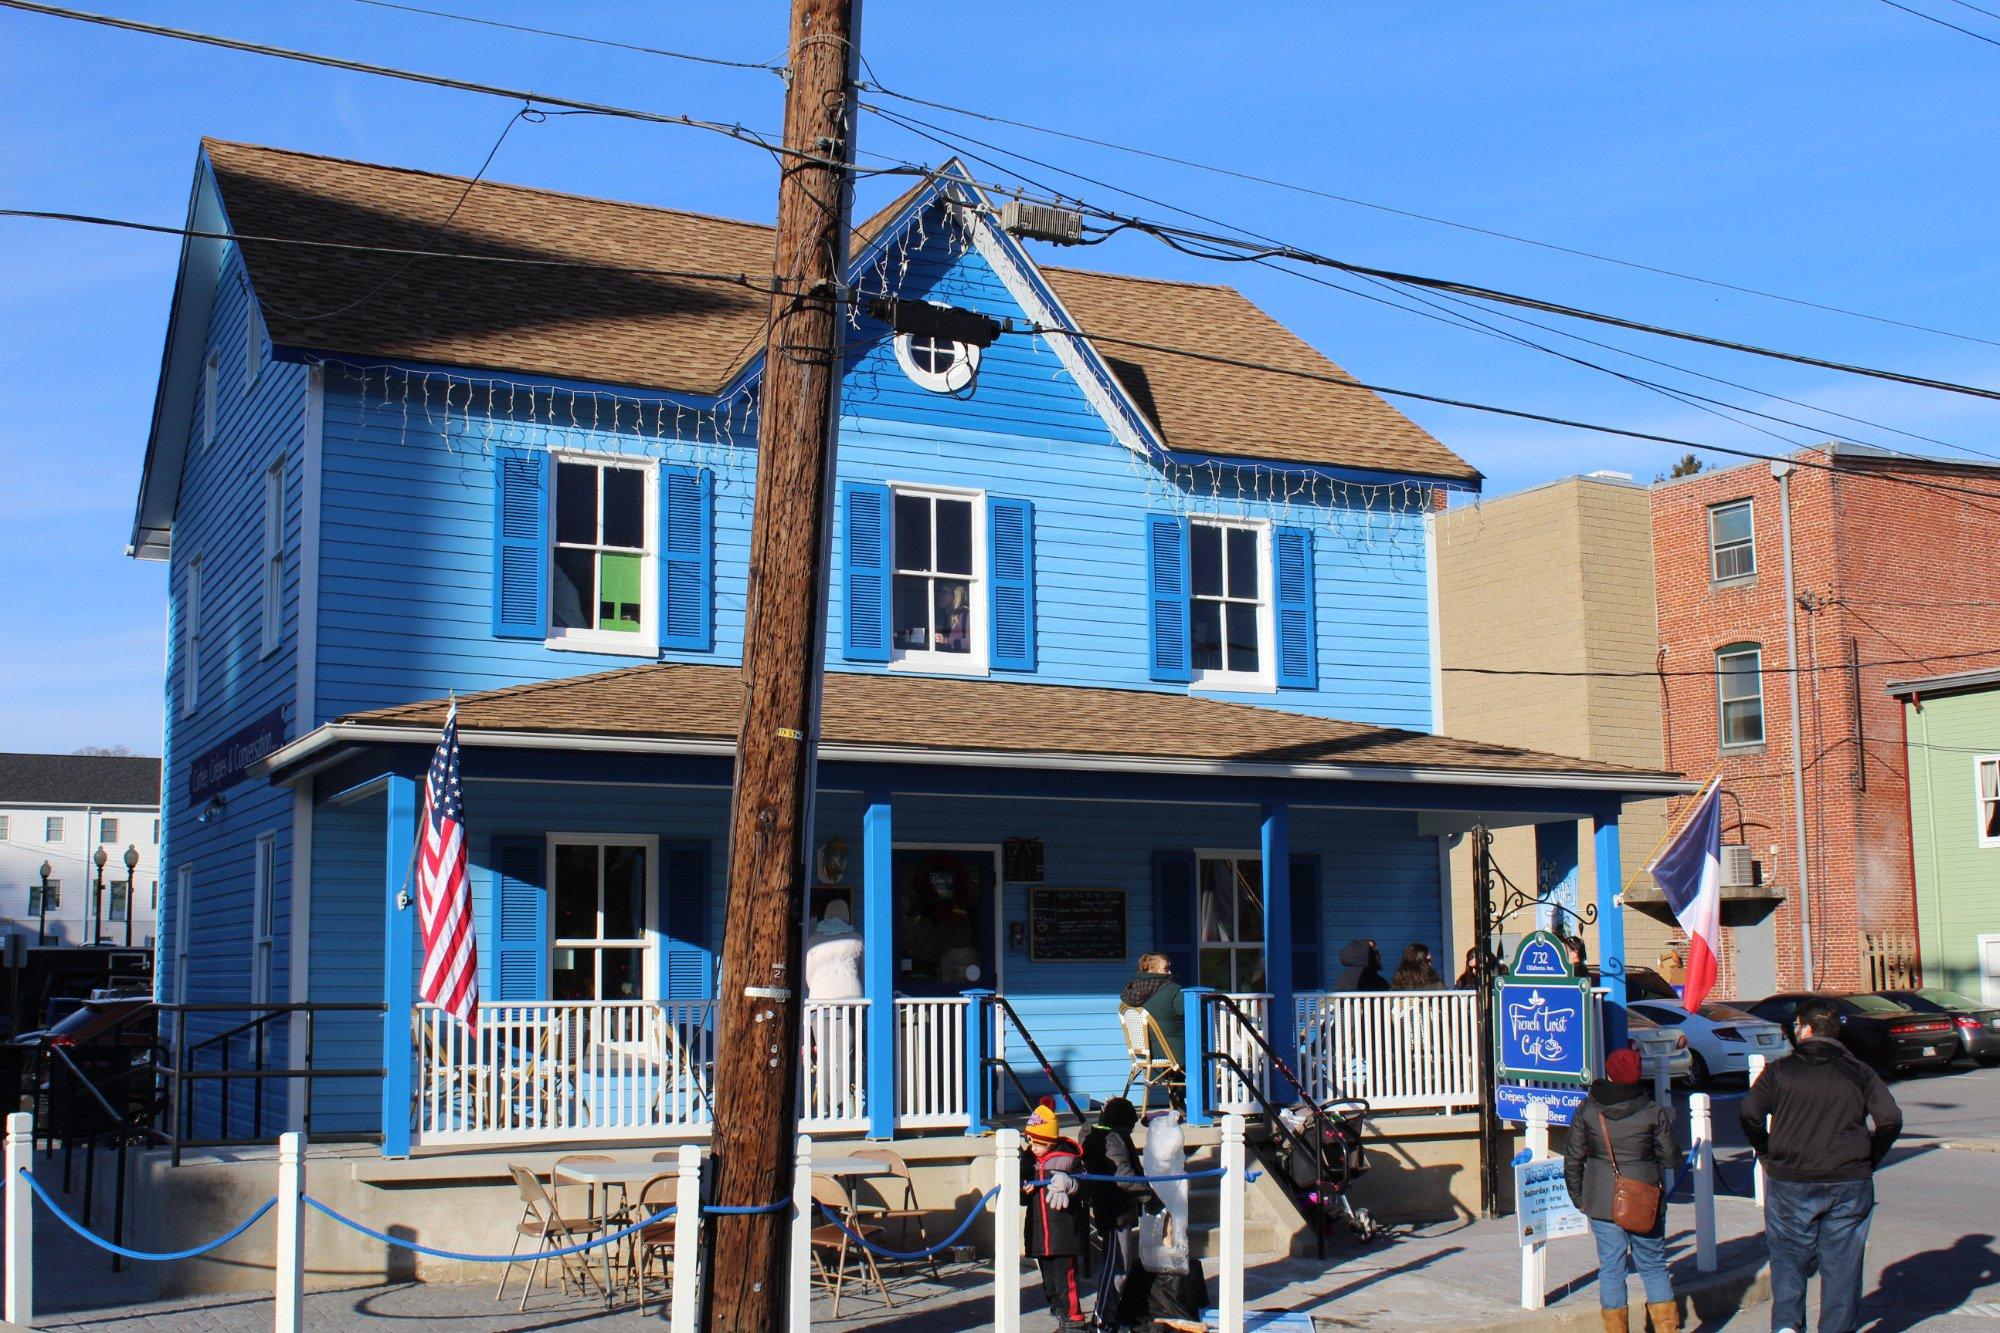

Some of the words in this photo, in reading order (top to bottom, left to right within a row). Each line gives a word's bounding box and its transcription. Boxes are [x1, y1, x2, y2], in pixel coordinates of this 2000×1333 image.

[1532, 951, 1548, 964] 732
[1509, 1003, 1540, 1041] French
[1521, 1034, 1546, 1066] Café
[1499, 1090, 1526, 1105] Crêpes,
[1527, 1092, 1560, 1108] Specialty
[1548, 1110, 1567, 1122] Beer
